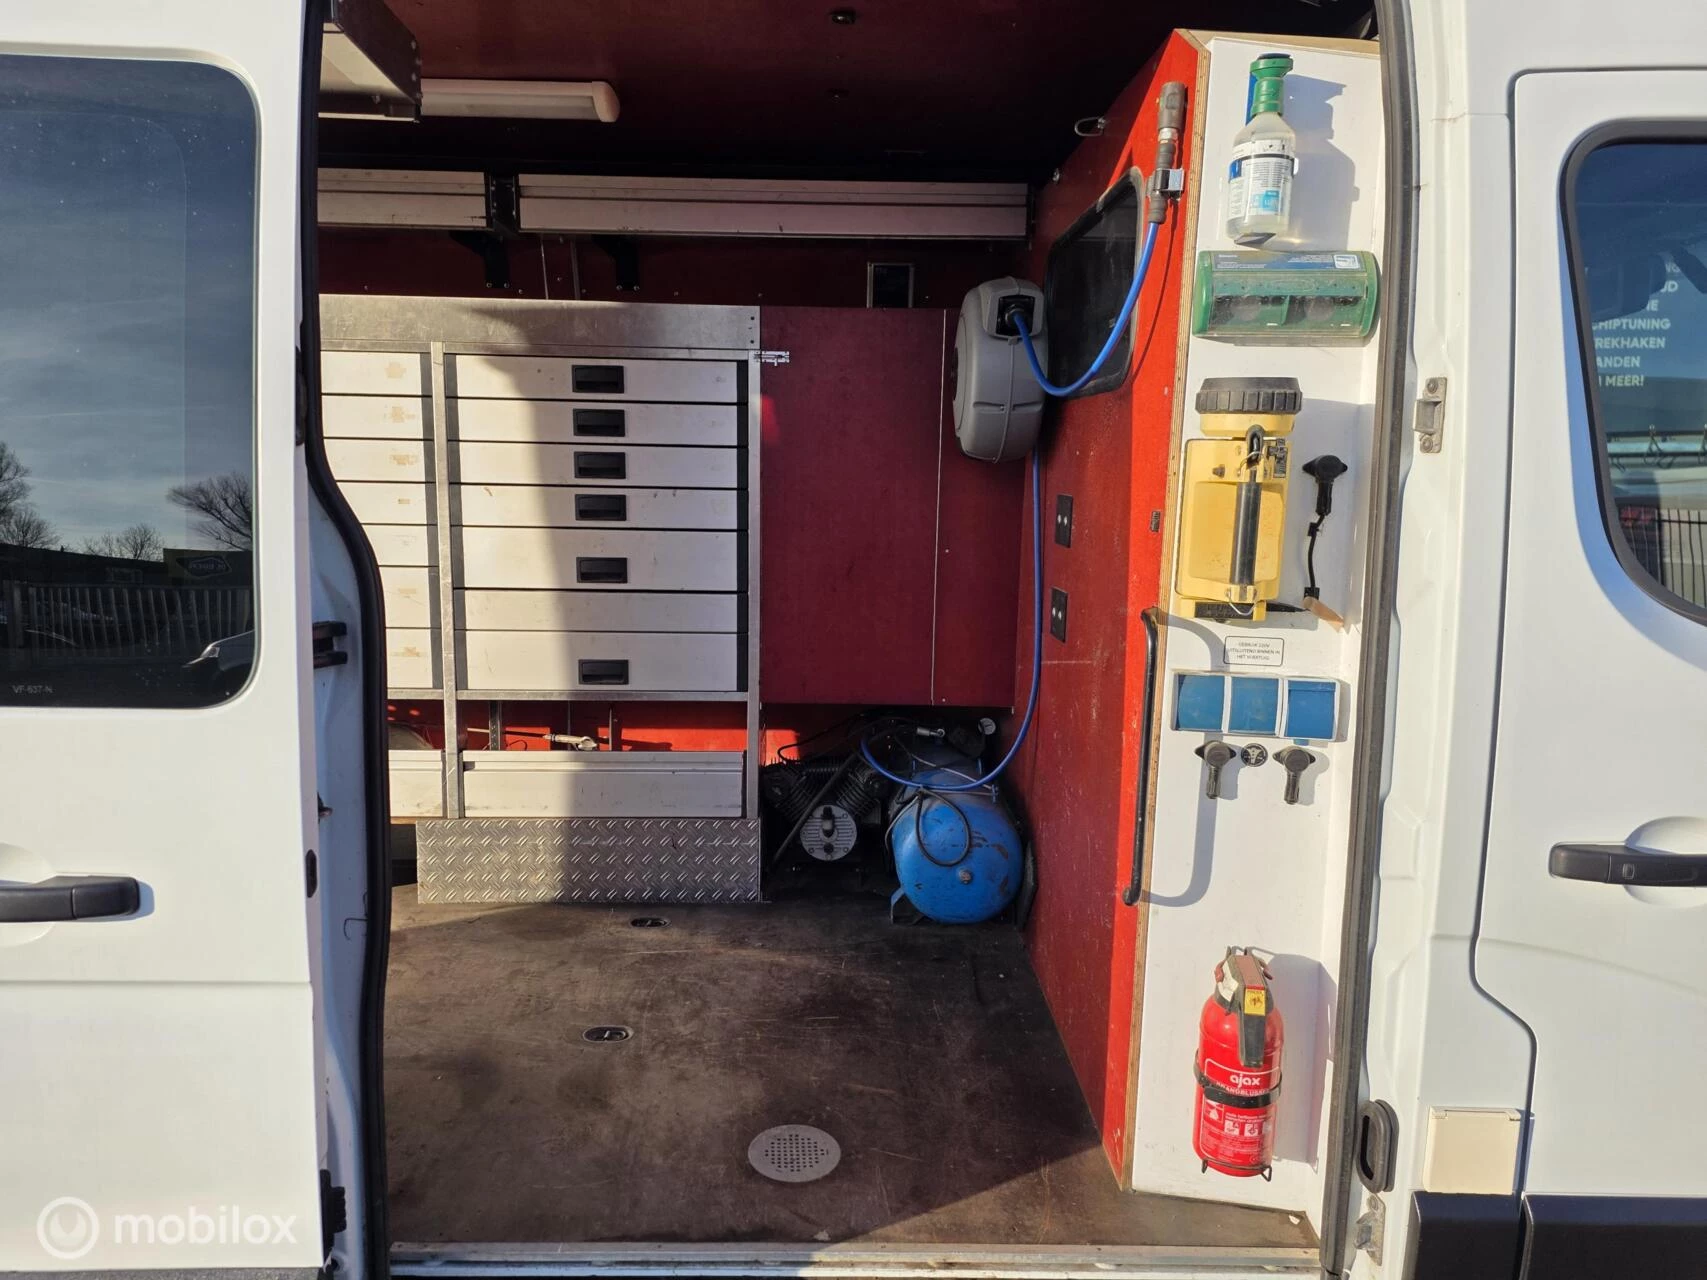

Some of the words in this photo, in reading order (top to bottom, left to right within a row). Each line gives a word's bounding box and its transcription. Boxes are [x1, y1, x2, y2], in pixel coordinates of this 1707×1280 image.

[1594, 337, 1666, 349] REKHAKEN
[1596, 356, 1641, 368] ANDEN
[1605, 375, 1644, 387] MEER!
[1230, 1073, 1261, 1088] ajax
